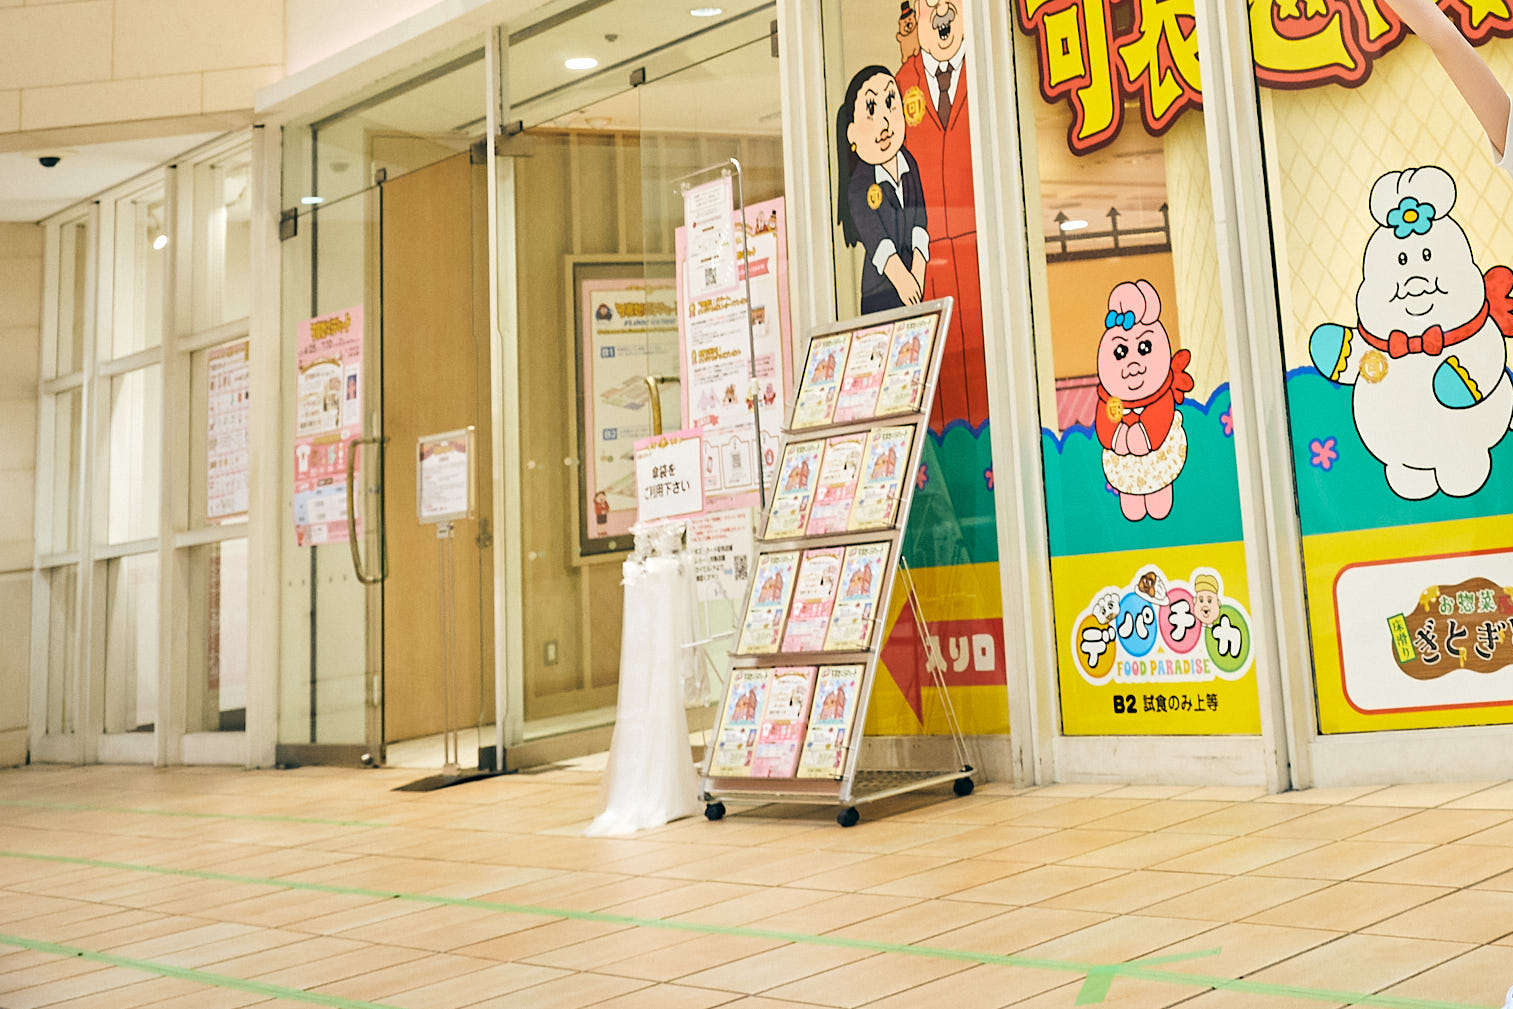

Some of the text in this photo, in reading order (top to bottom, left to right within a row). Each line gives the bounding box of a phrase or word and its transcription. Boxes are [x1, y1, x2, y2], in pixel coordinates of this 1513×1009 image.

[1080, 598, 1242, 668] デパチカ
[1117, 658, 1211, 676] FOOD PARADISE
[1113, 693, 1219, 714] B2 試食のみ上等
